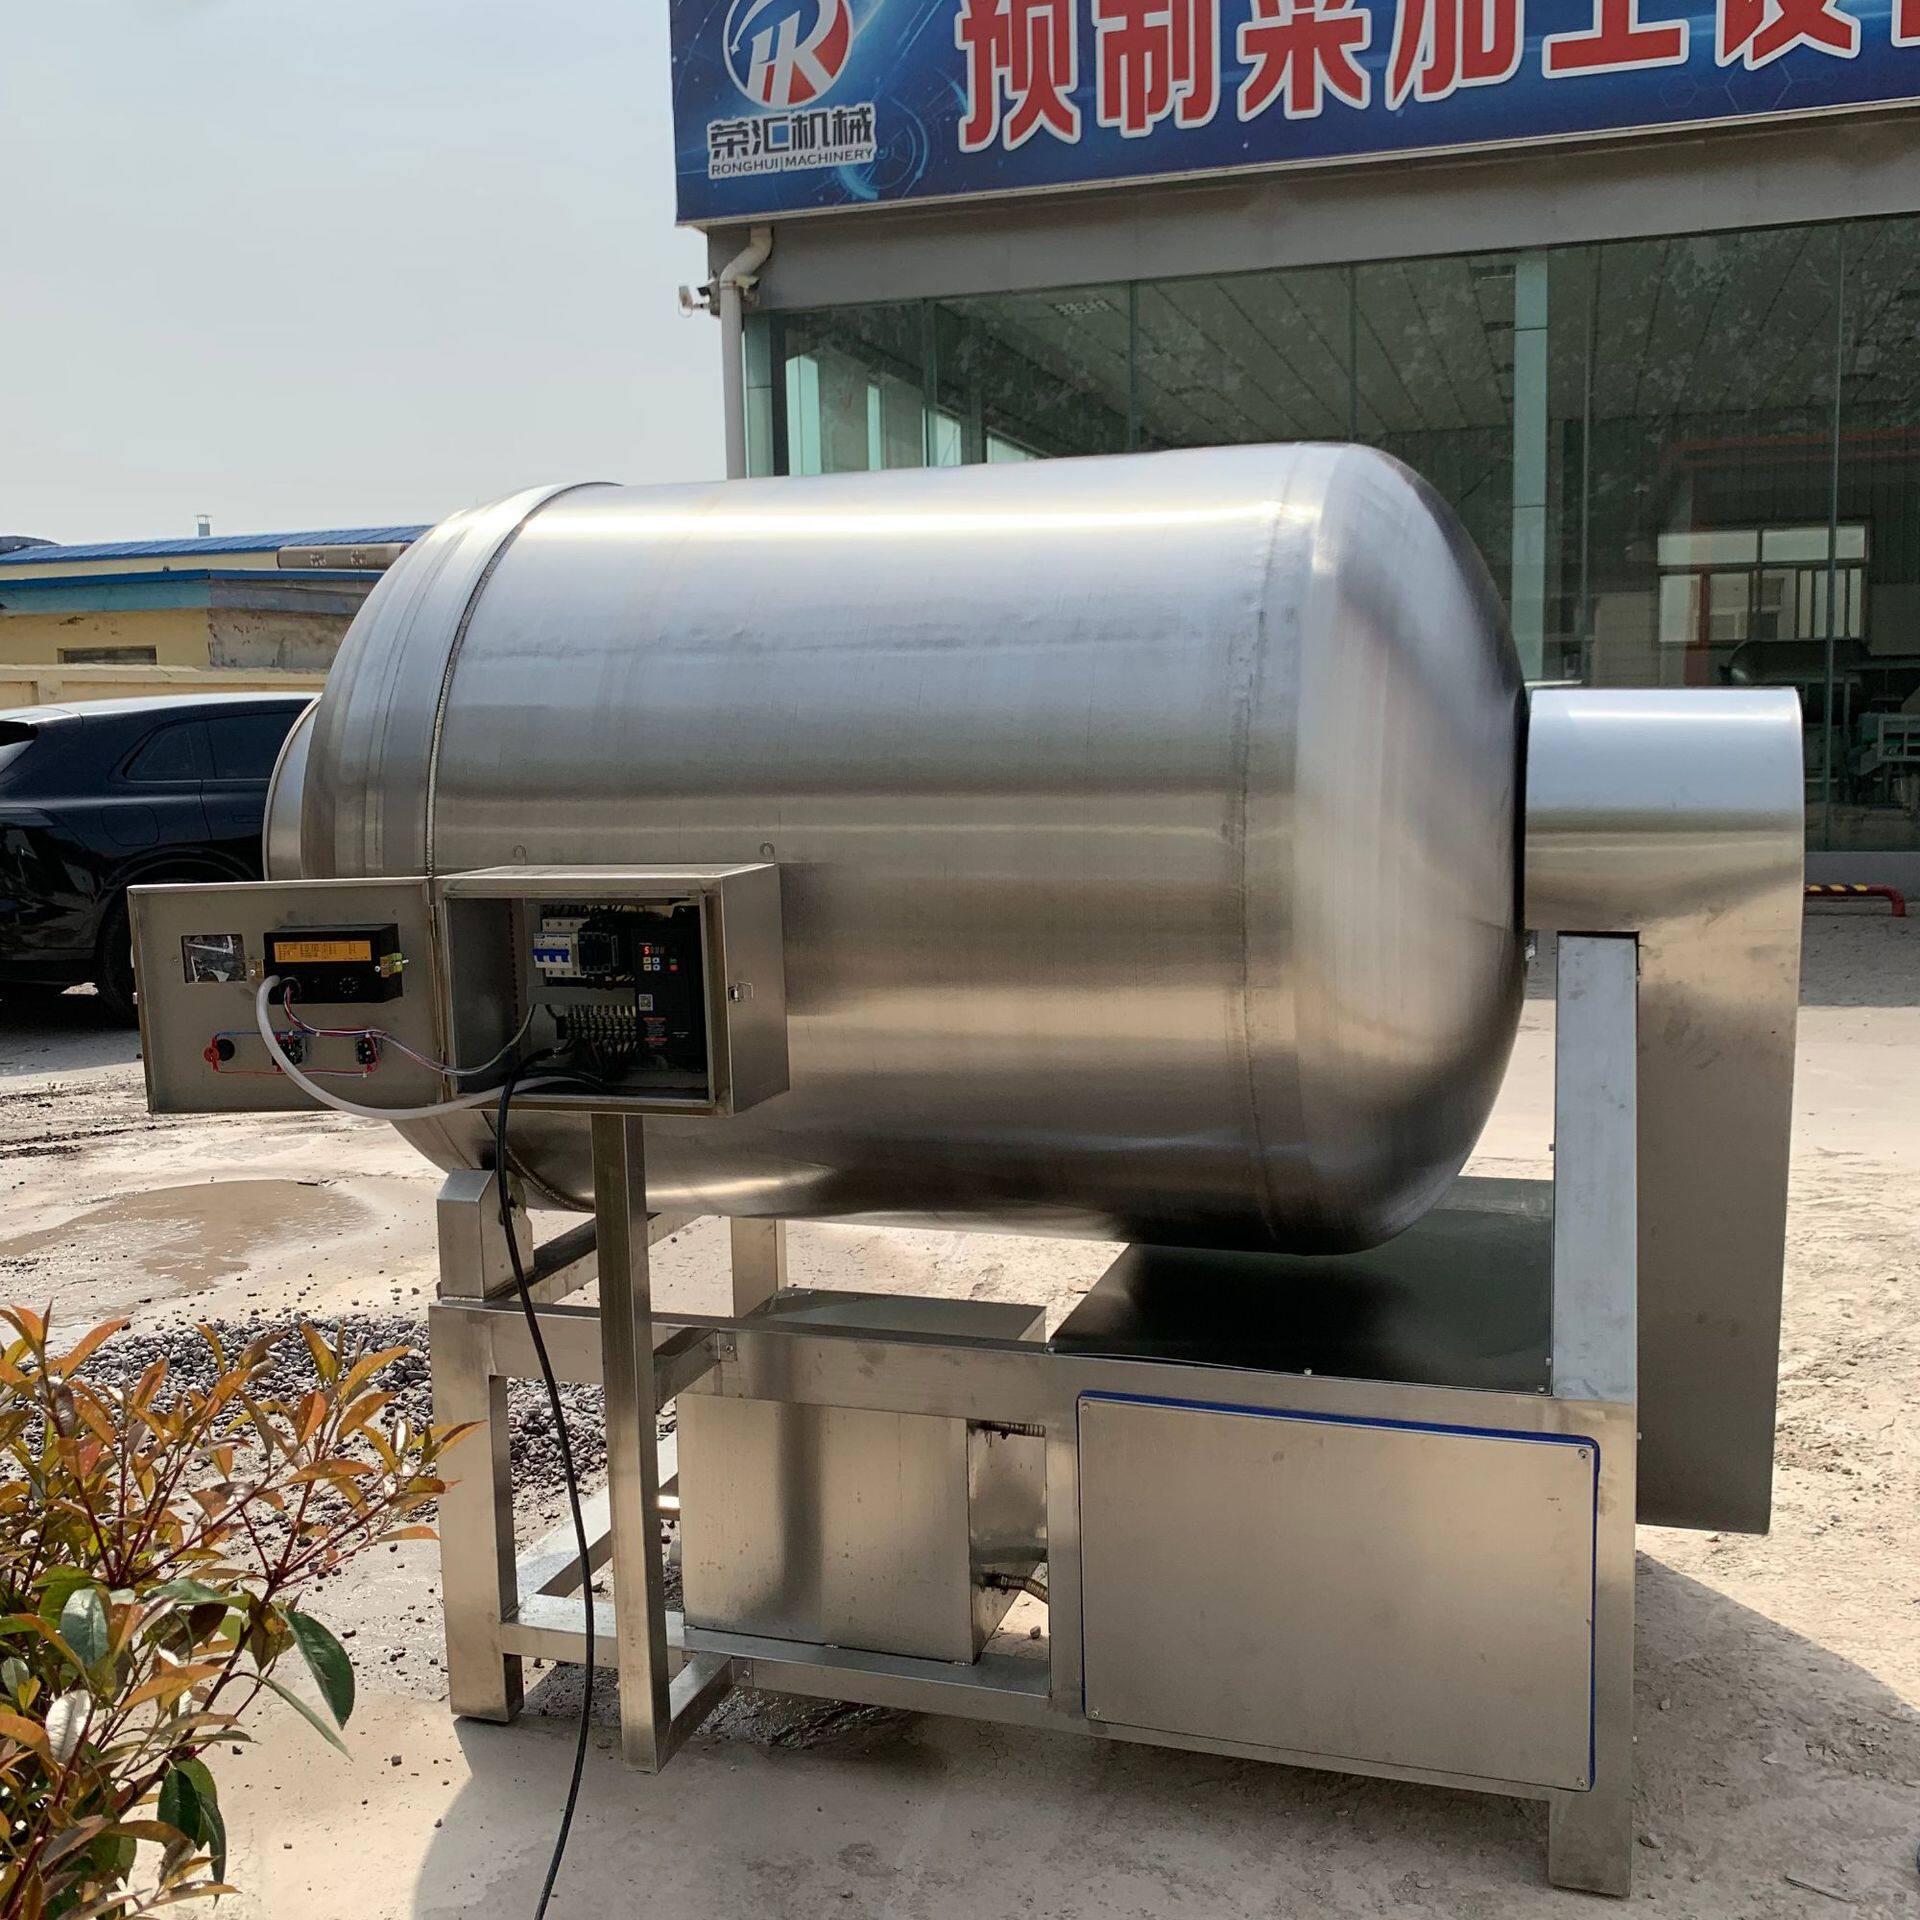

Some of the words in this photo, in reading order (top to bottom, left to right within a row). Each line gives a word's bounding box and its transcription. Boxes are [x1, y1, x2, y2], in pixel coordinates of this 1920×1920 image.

[957, 0, 1920, 151] 预制菜加
[711, 107, 873, 159] 荣汇机械
[711, 158, 779, 176] RONGHUI
[785, 149, 873, 167] MACHINERY
